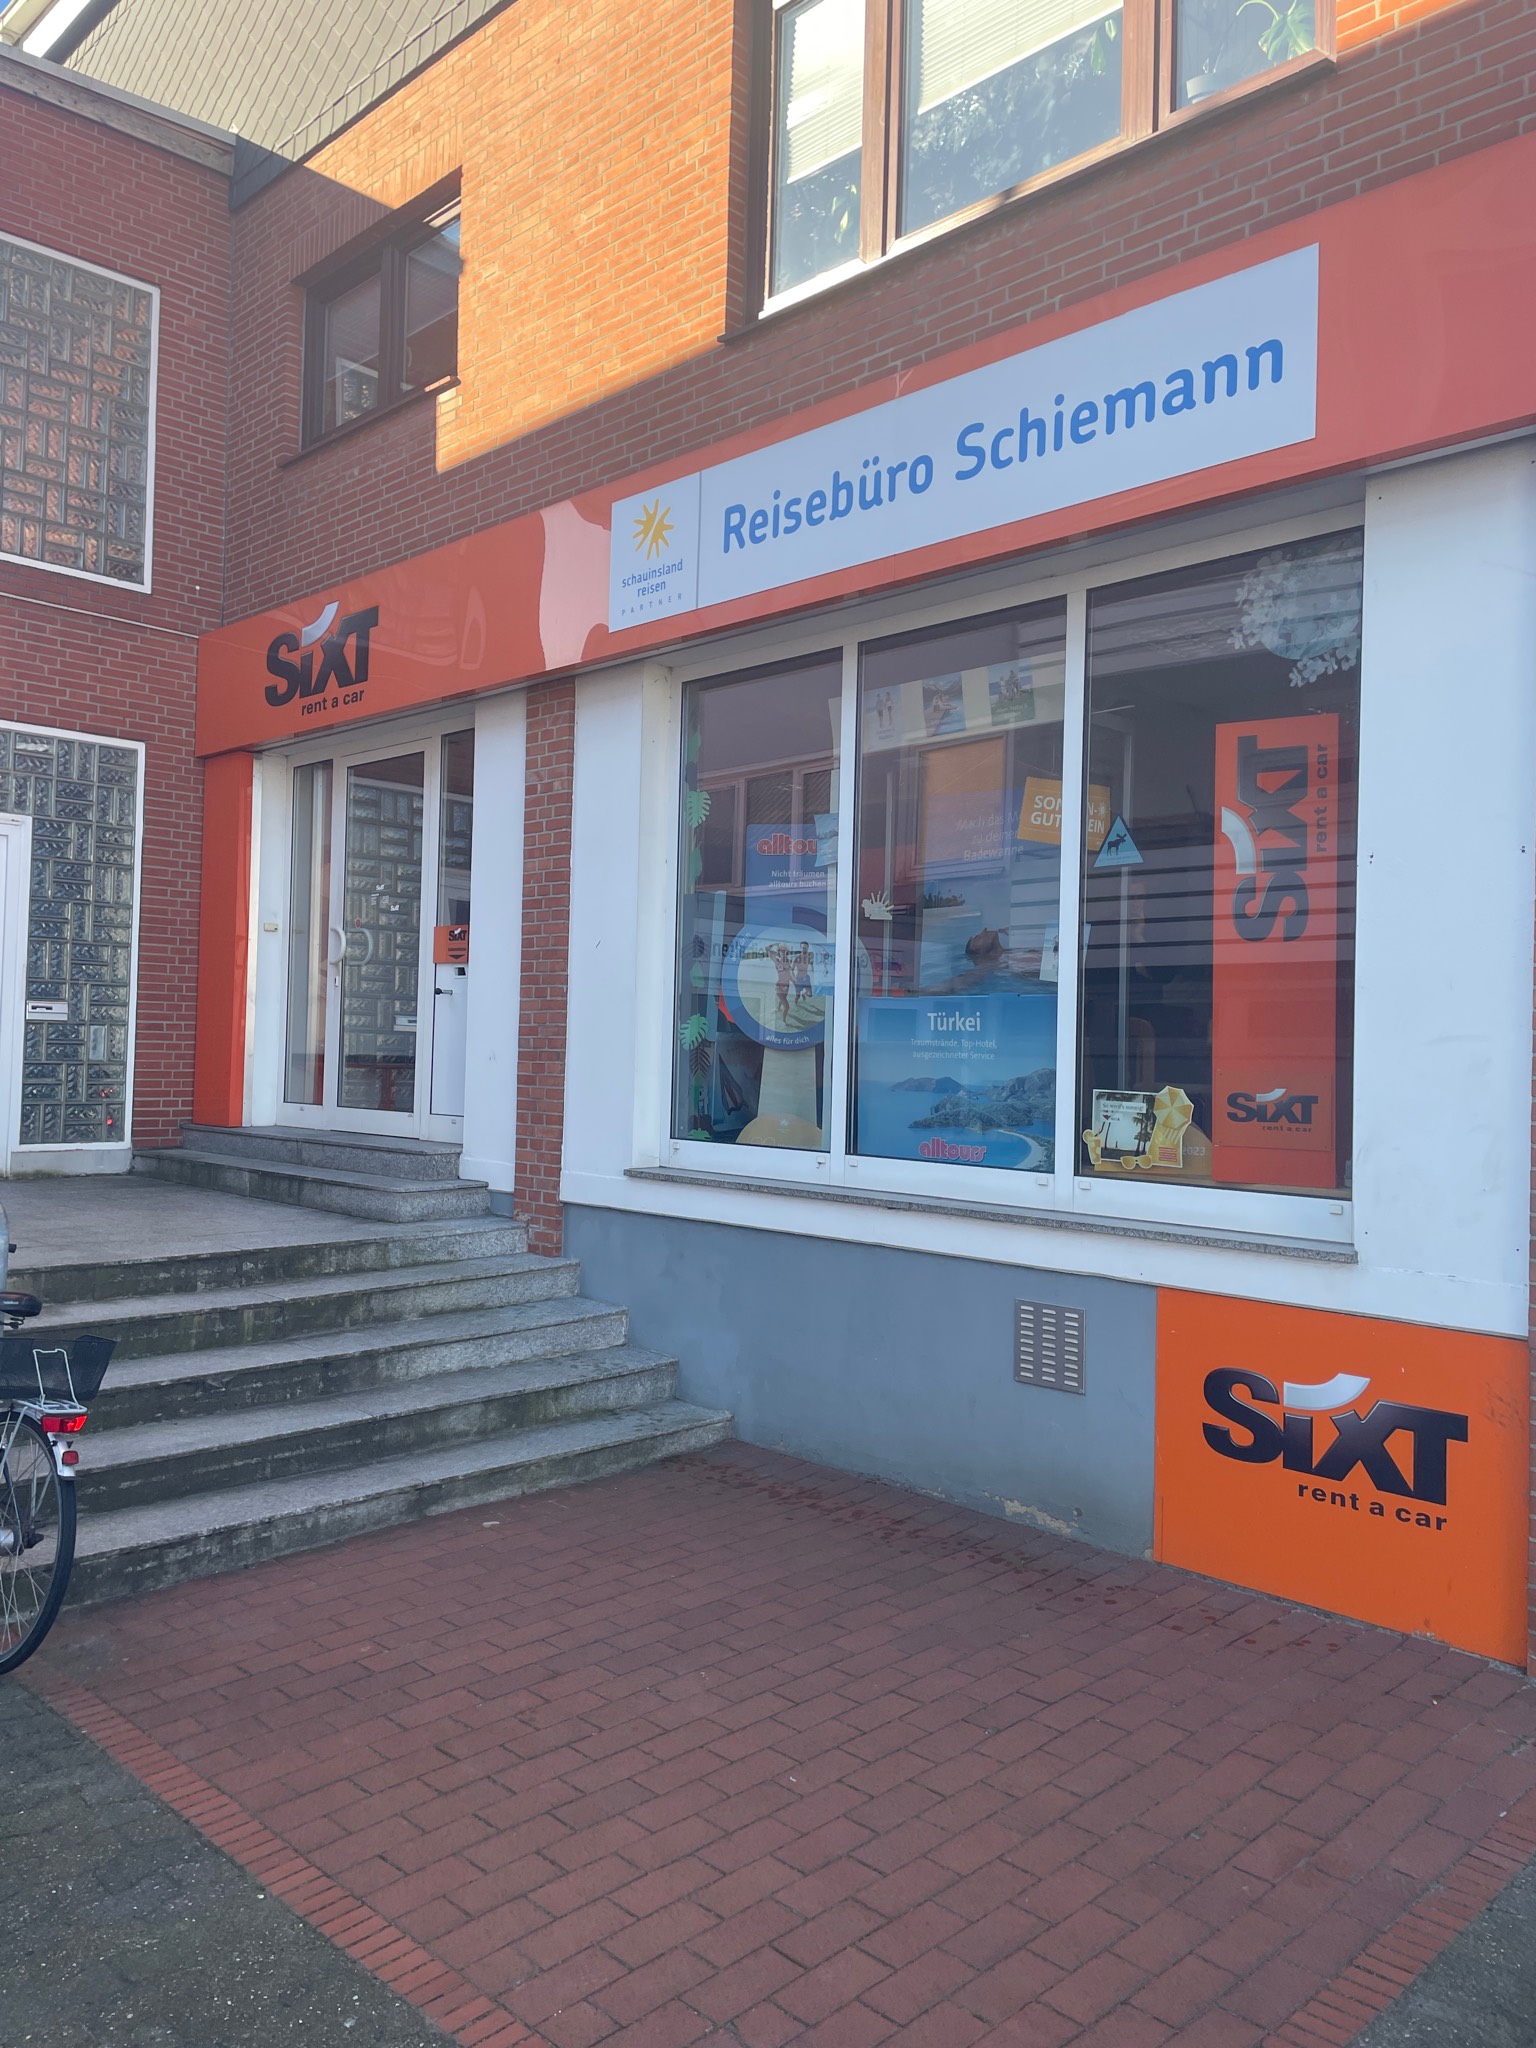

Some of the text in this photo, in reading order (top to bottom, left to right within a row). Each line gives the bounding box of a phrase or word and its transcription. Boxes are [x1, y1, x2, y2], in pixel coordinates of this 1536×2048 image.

[723, 338, 1284, 553] Reisebüro Schiemann
[621, 558, 683, 588] schauinsland
[637, 581, 666, 598] reisen
[621, 593, 682, 616] PARTNER
[301, 690, 365, 716] rent a car
[1314, 744, 1328, 852] rent a car
[927, 1011, 981, 1031] Türkei
[765, 1034, 810, 1045] alles für dich
[969, 1051, 995, 1060] Service
[919, 1136, 986, 1162] alltours
[1298, 1484, 1448, 1531] rent a car
